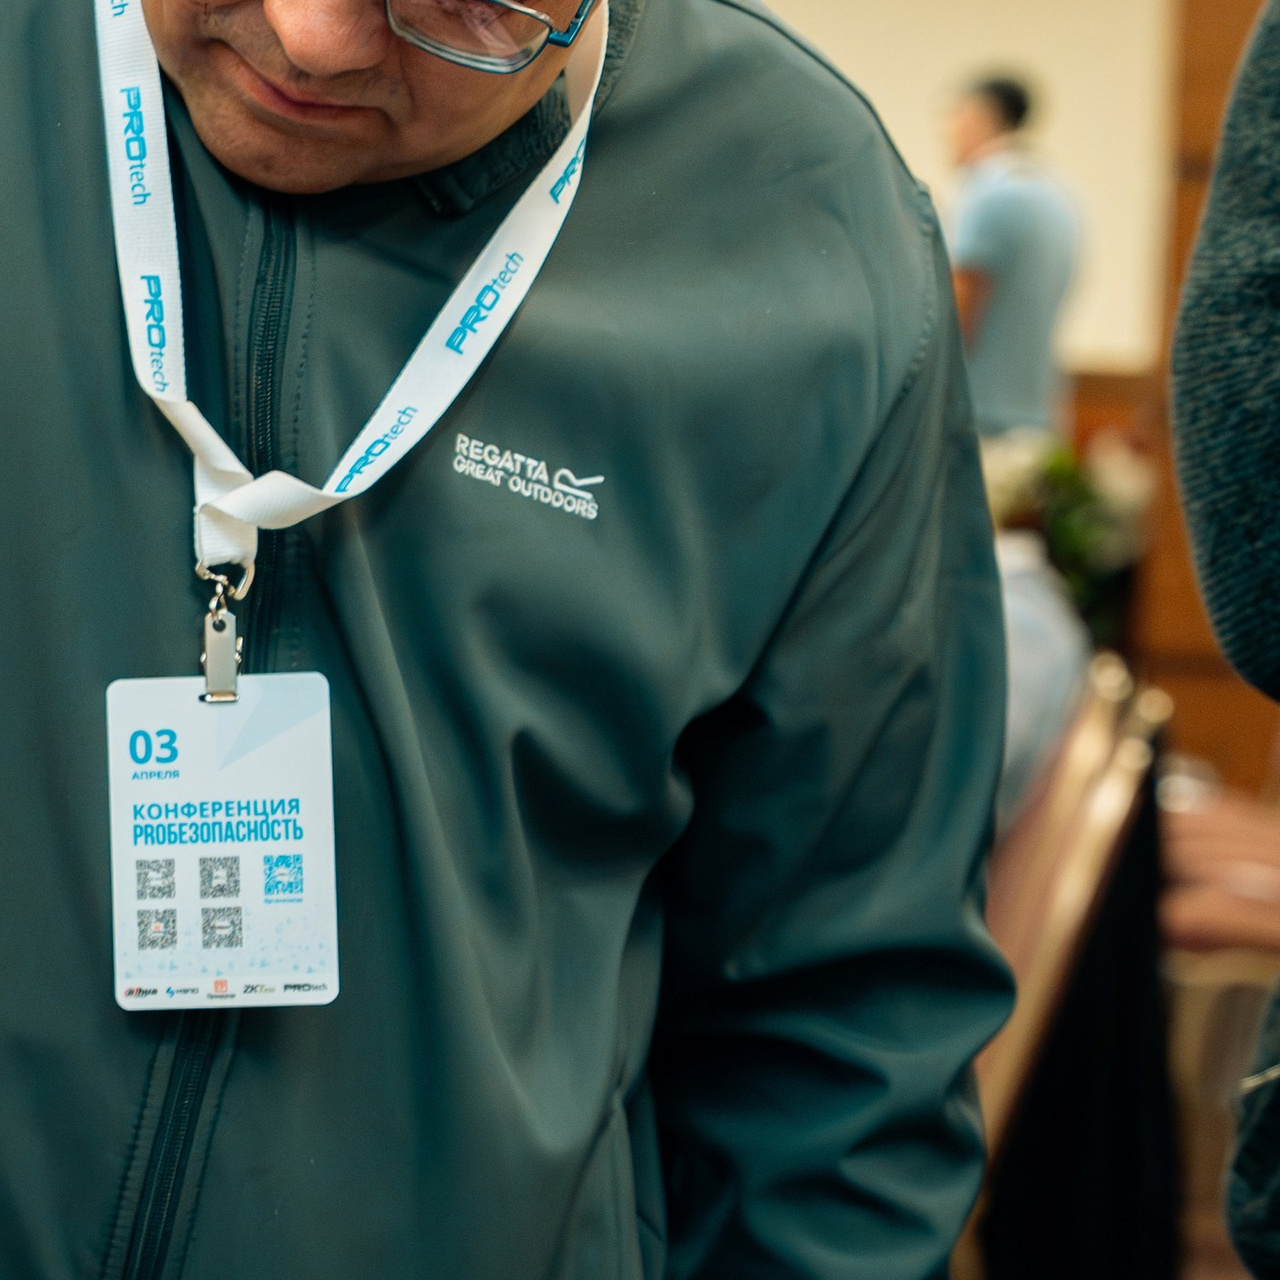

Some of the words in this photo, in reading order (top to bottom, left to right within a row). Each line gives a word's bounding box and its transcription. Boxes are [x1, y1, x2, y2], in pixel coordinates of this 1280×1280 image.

[120, 86, 151, 206] PROtech
[140, 275, 169, 393] PROtech
[445, 251, 524, 355] PROtech
[334, 405, 419, 493] PROtech
[455, 432, 550, 485] REGATTA
[453, 454, 505, 487] GREAT
[508, 474, 599, 520] OUTDOORS
[128, 728, 179, 765] 03
[131, 770, 180, 780] АПРЕЛЯ
[133, 798, 301, 821] КОНФЕРЕНЦИЯ
